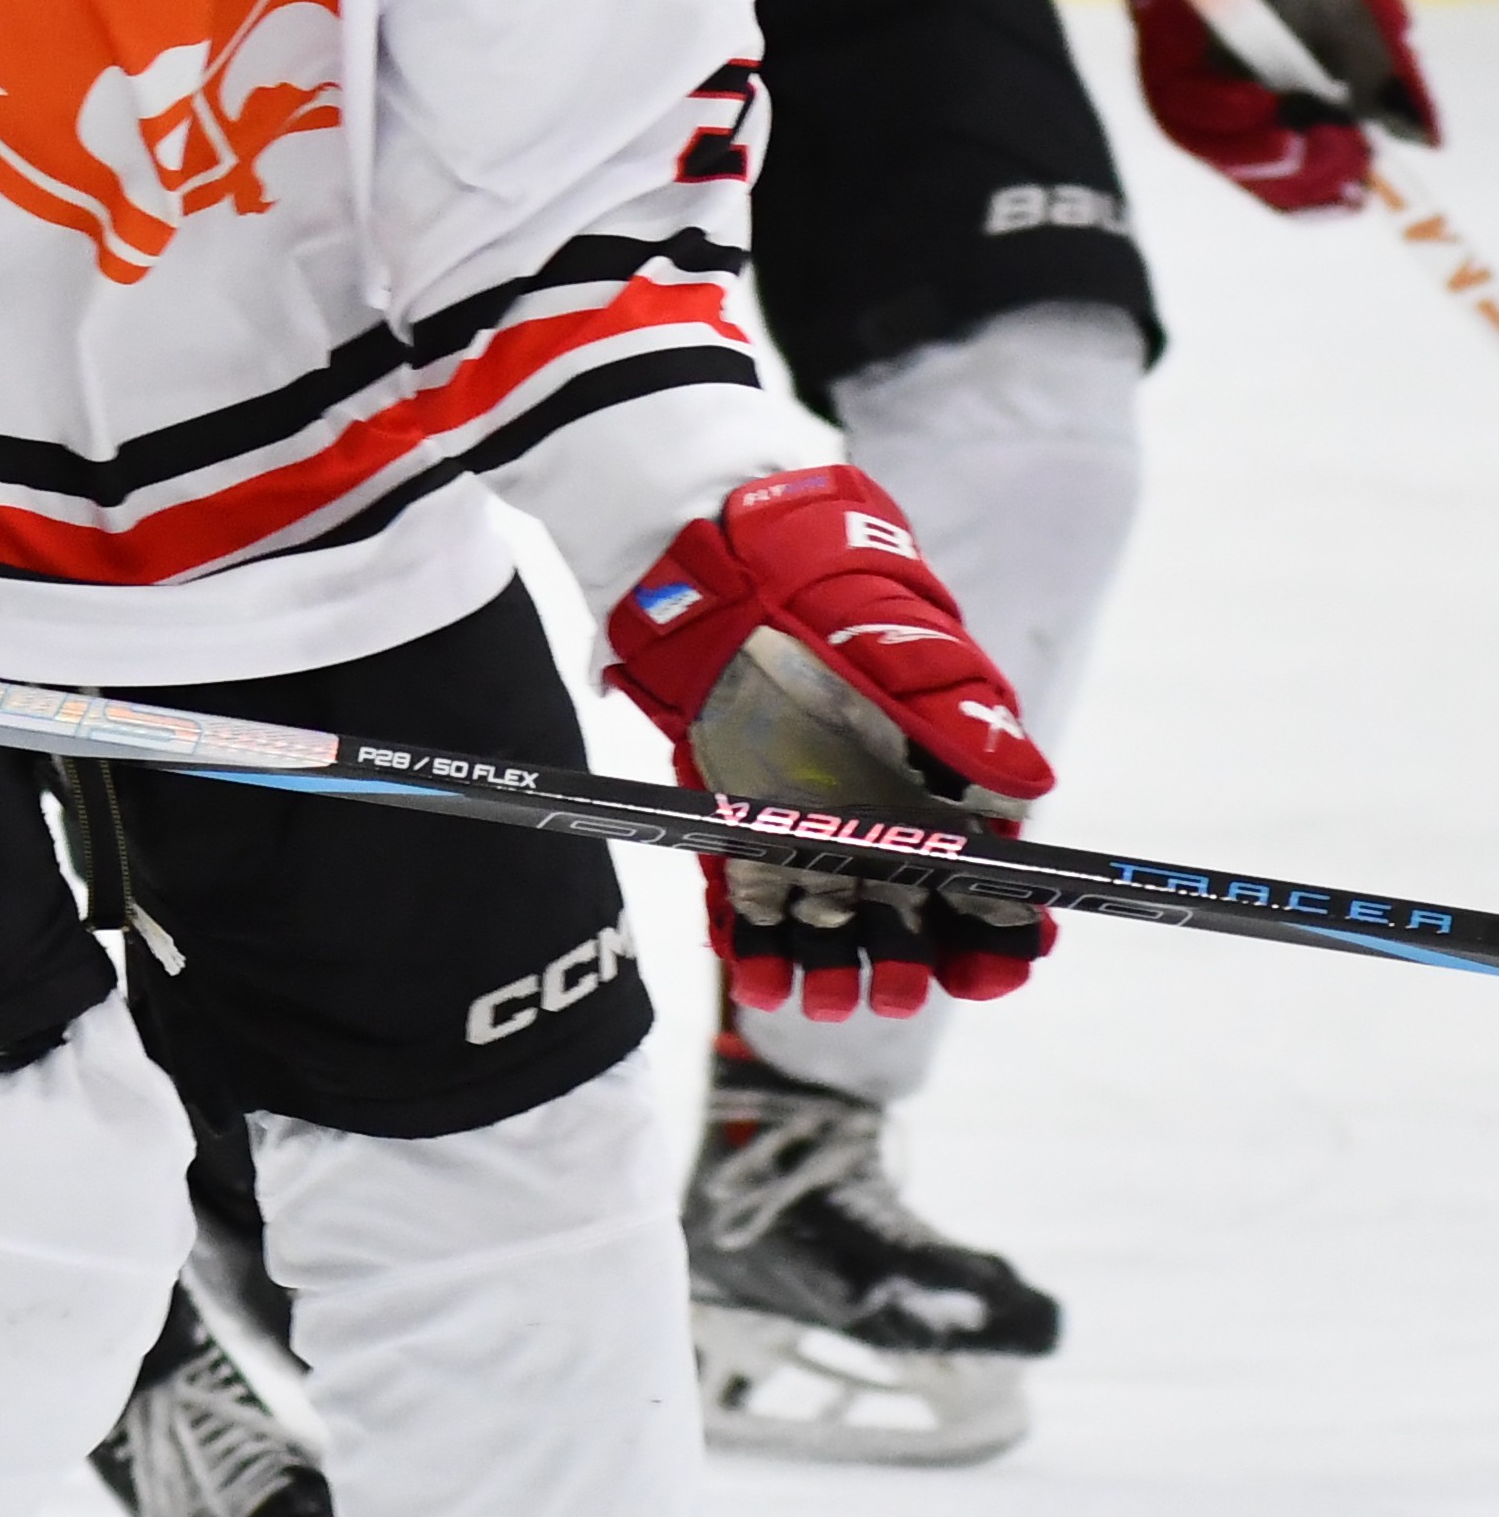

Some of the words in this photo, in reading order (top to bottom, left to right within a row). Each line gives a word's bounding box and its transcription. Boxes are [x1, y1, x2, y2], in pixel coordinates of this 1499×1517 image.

[357, 745, 412, 770] P28
[413, 756, 431, 771] /
[432, 757, 469, 778] 50
[472, 763, 540, 789] FLEX
[751, 804, 969, 860] BAUER
[1109, 861, 1453, 935] TRACER
